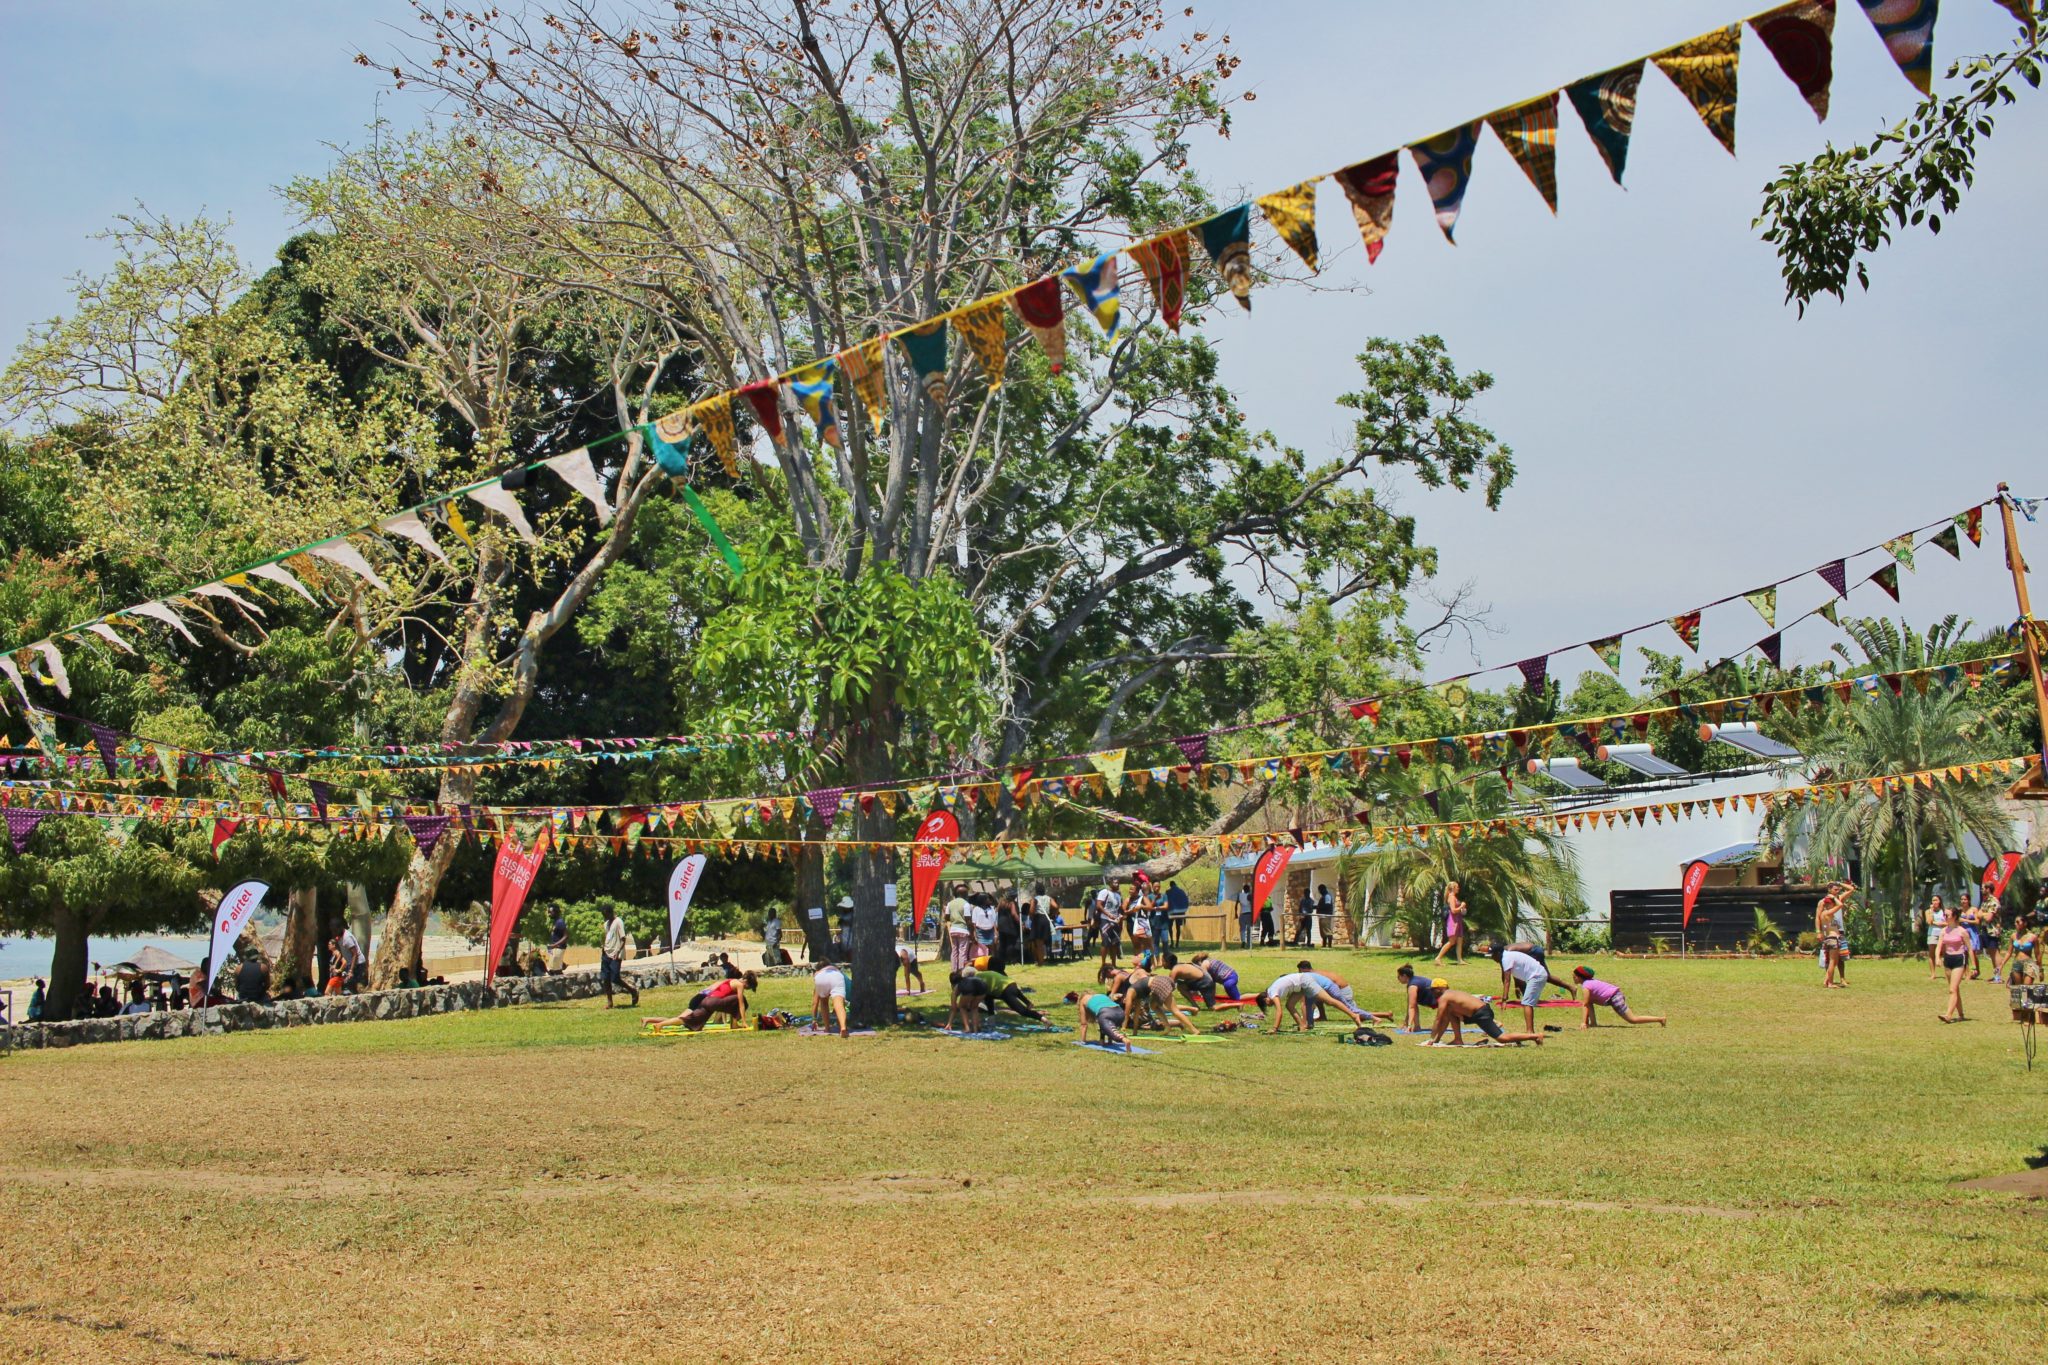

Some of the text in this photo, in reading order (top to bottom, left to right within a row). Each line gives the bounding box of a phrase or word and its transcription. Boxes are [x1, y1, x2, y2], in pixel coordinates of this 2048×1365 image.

[501, 856, 531, 881] RISING
[680, 862, 696, 889] airtel
[1266, 852, 1284, 874] airtel
[499, 866, 527, 890] STARS
[230, 889, 253, 921] airtel
